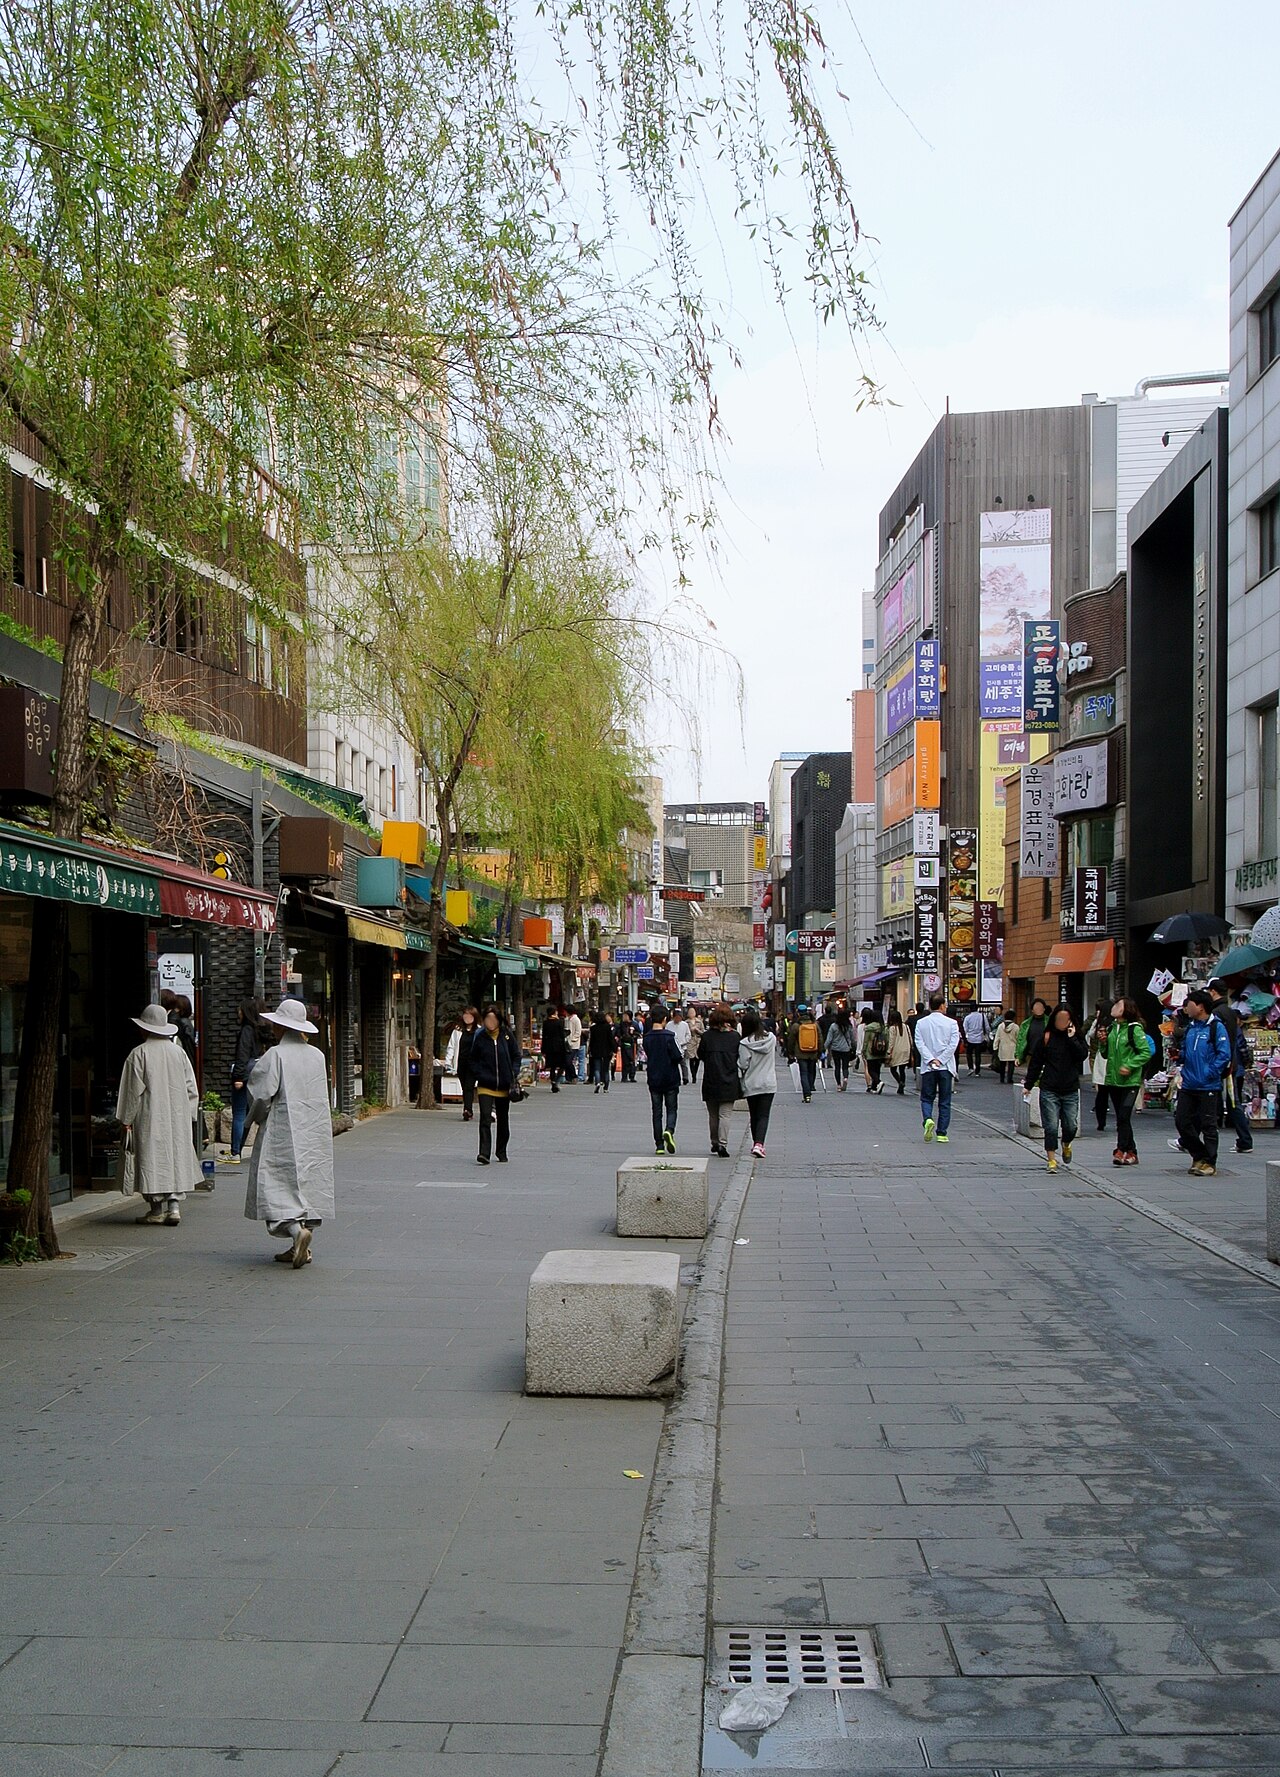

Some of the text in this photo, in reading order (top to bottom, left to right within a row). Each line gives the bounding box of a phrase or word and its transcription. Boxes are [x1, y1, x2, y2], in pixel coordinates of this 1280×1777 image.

[918, 643, 936, 704] 세종화랑
[1025, 709, 1039, 720] 3F
[1024, 767, 1044, 868] 운경표구사
[1046, 861, 1056, 869] 2F
[1084, 868, 1099, 924] 국제자수원
[918, 913, 934, 952] 칼국수
[979, 903, 993, 957] 한양화랑
